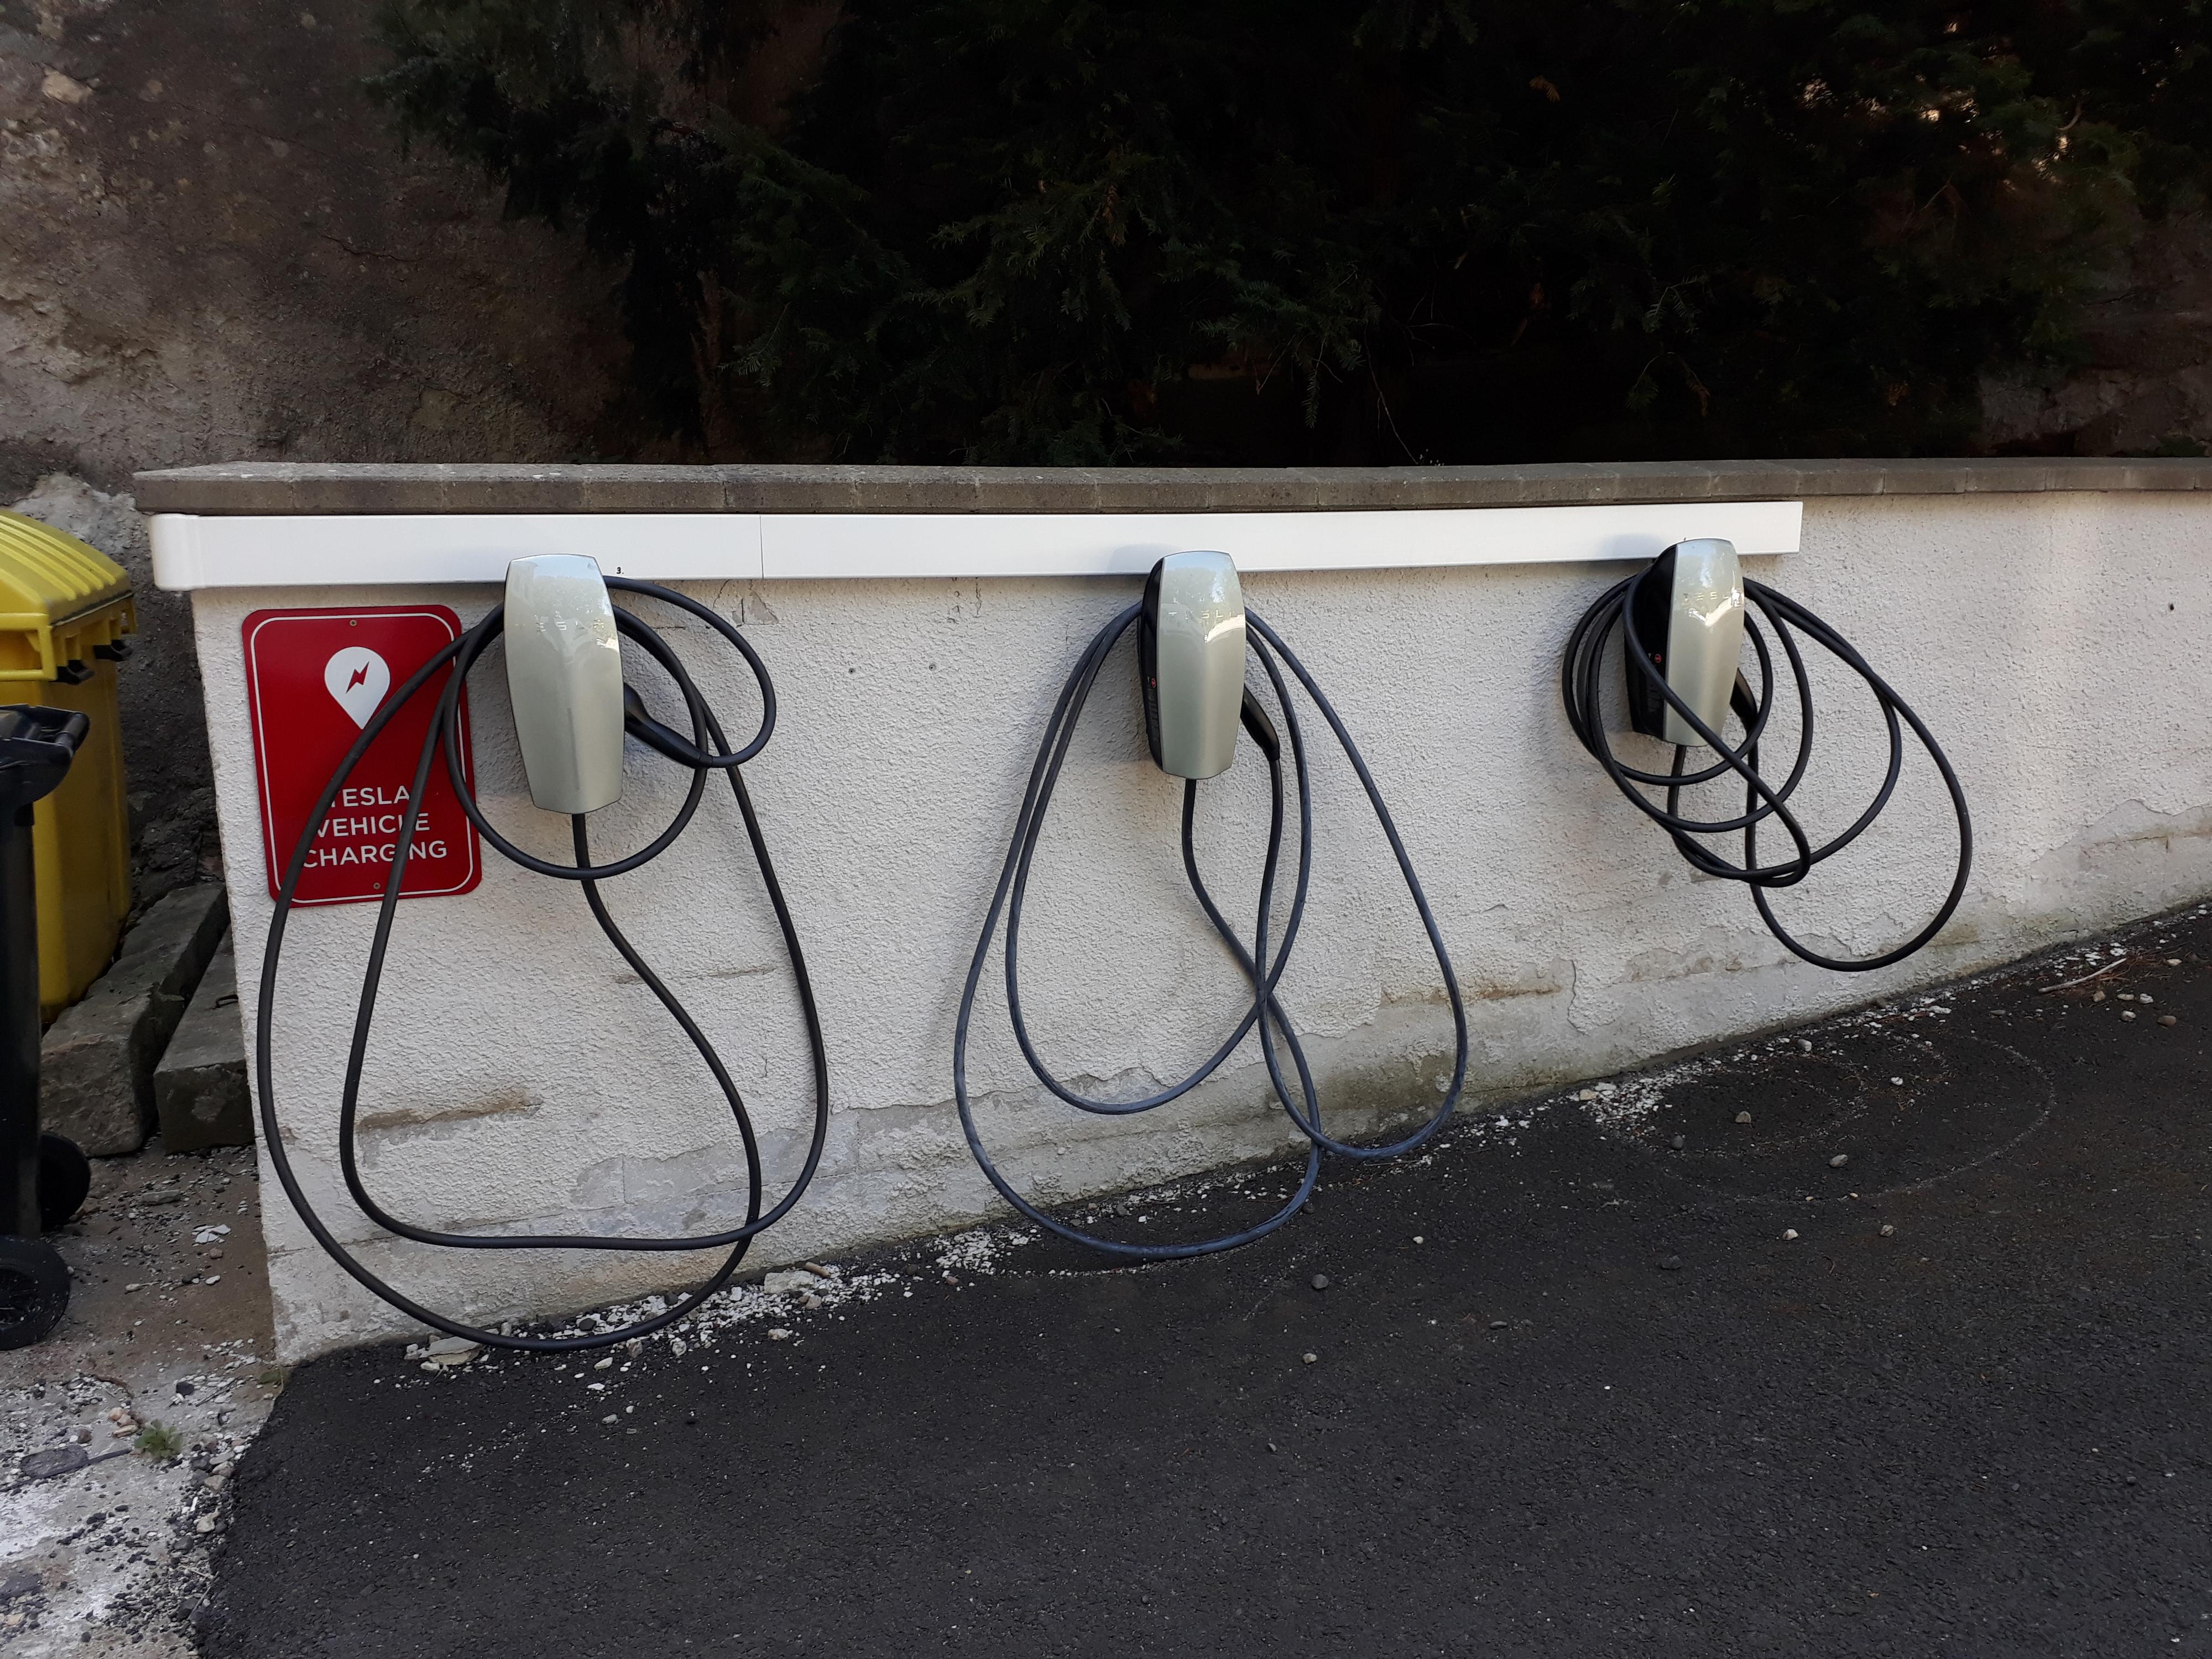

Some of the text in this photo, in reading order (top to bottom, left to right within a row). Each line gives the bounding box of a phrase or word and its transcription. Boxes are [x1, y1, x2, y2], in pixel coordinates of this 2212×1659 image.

[1168, 609, 1239, 620] TSL
[331, 785, 410, 808] ESLA
[304, 840, 447, 868] CHARGNG
